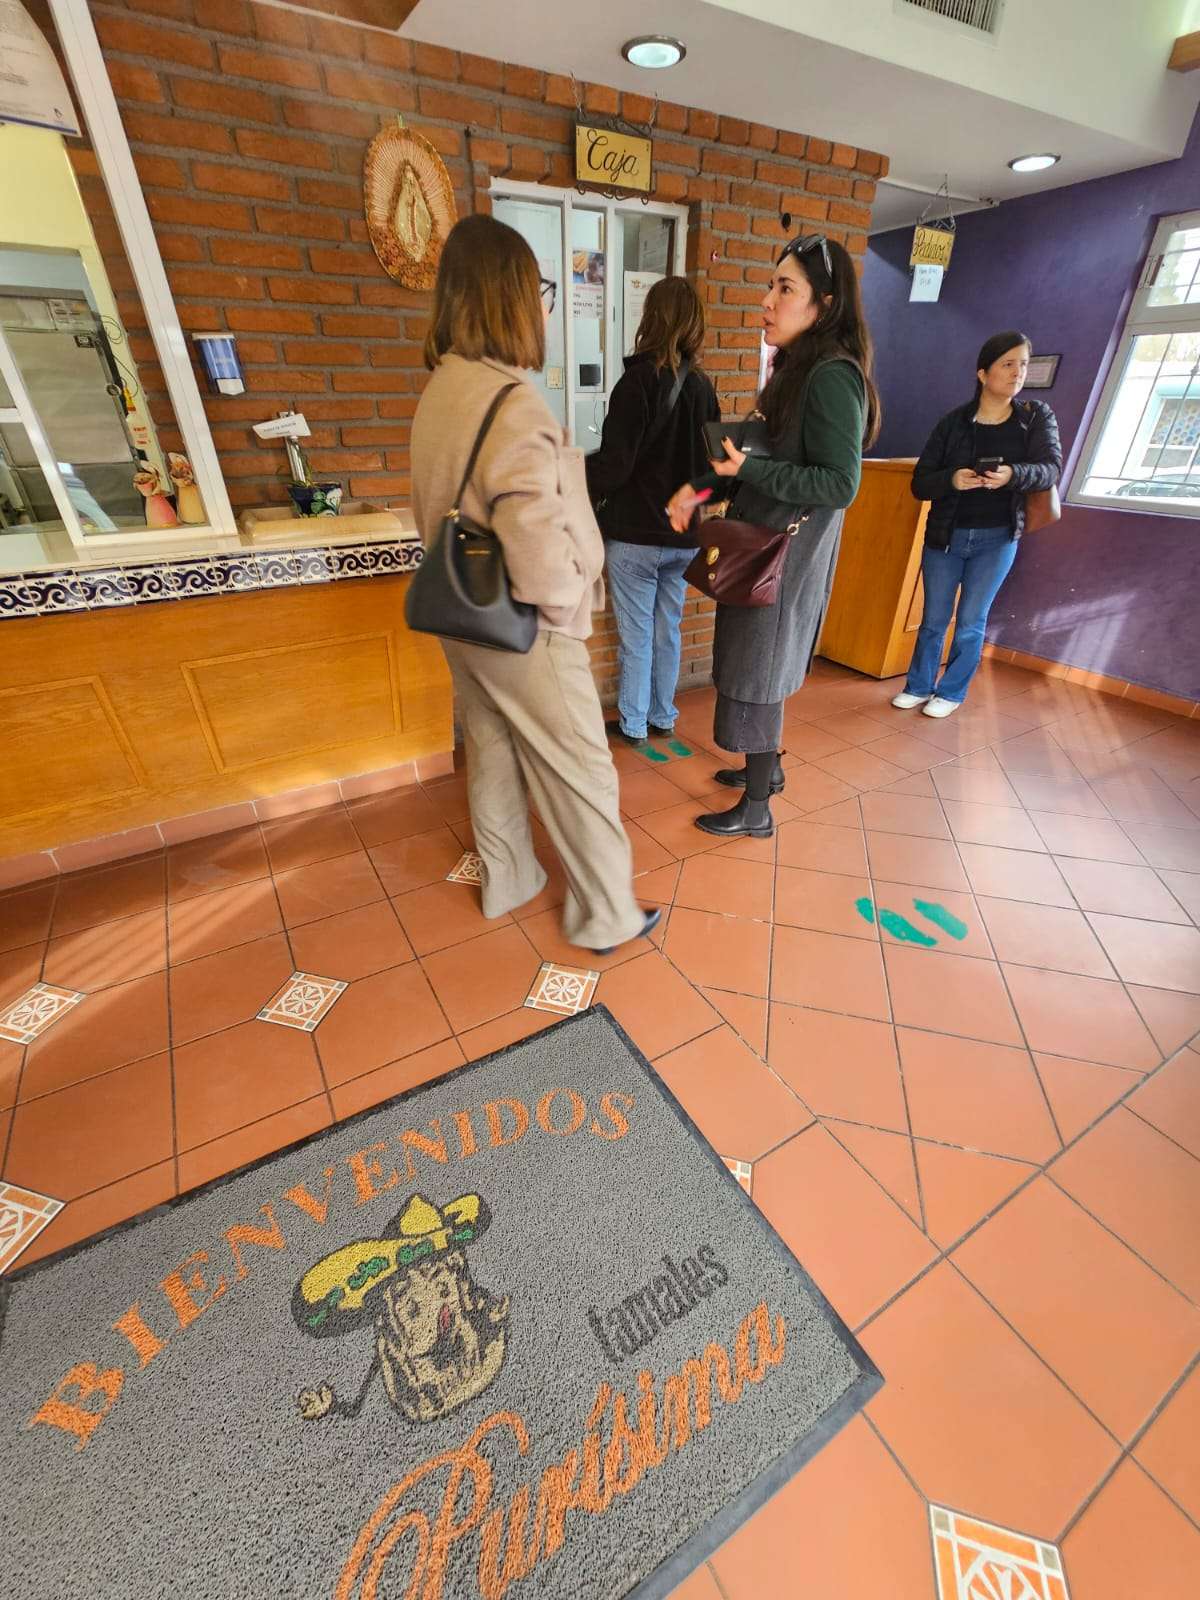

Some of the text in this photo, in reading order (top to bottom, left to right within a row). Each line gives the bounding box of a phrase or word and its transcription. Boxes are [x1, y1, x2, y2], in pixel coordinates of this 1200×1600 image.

[587, 128, 639, 183] Caja
[26, 1087, 637, 1453] BIENVENIDOS
[587, 1244, 729, 1363] tamales
[334, 1300, 787, 1600] Purísima
